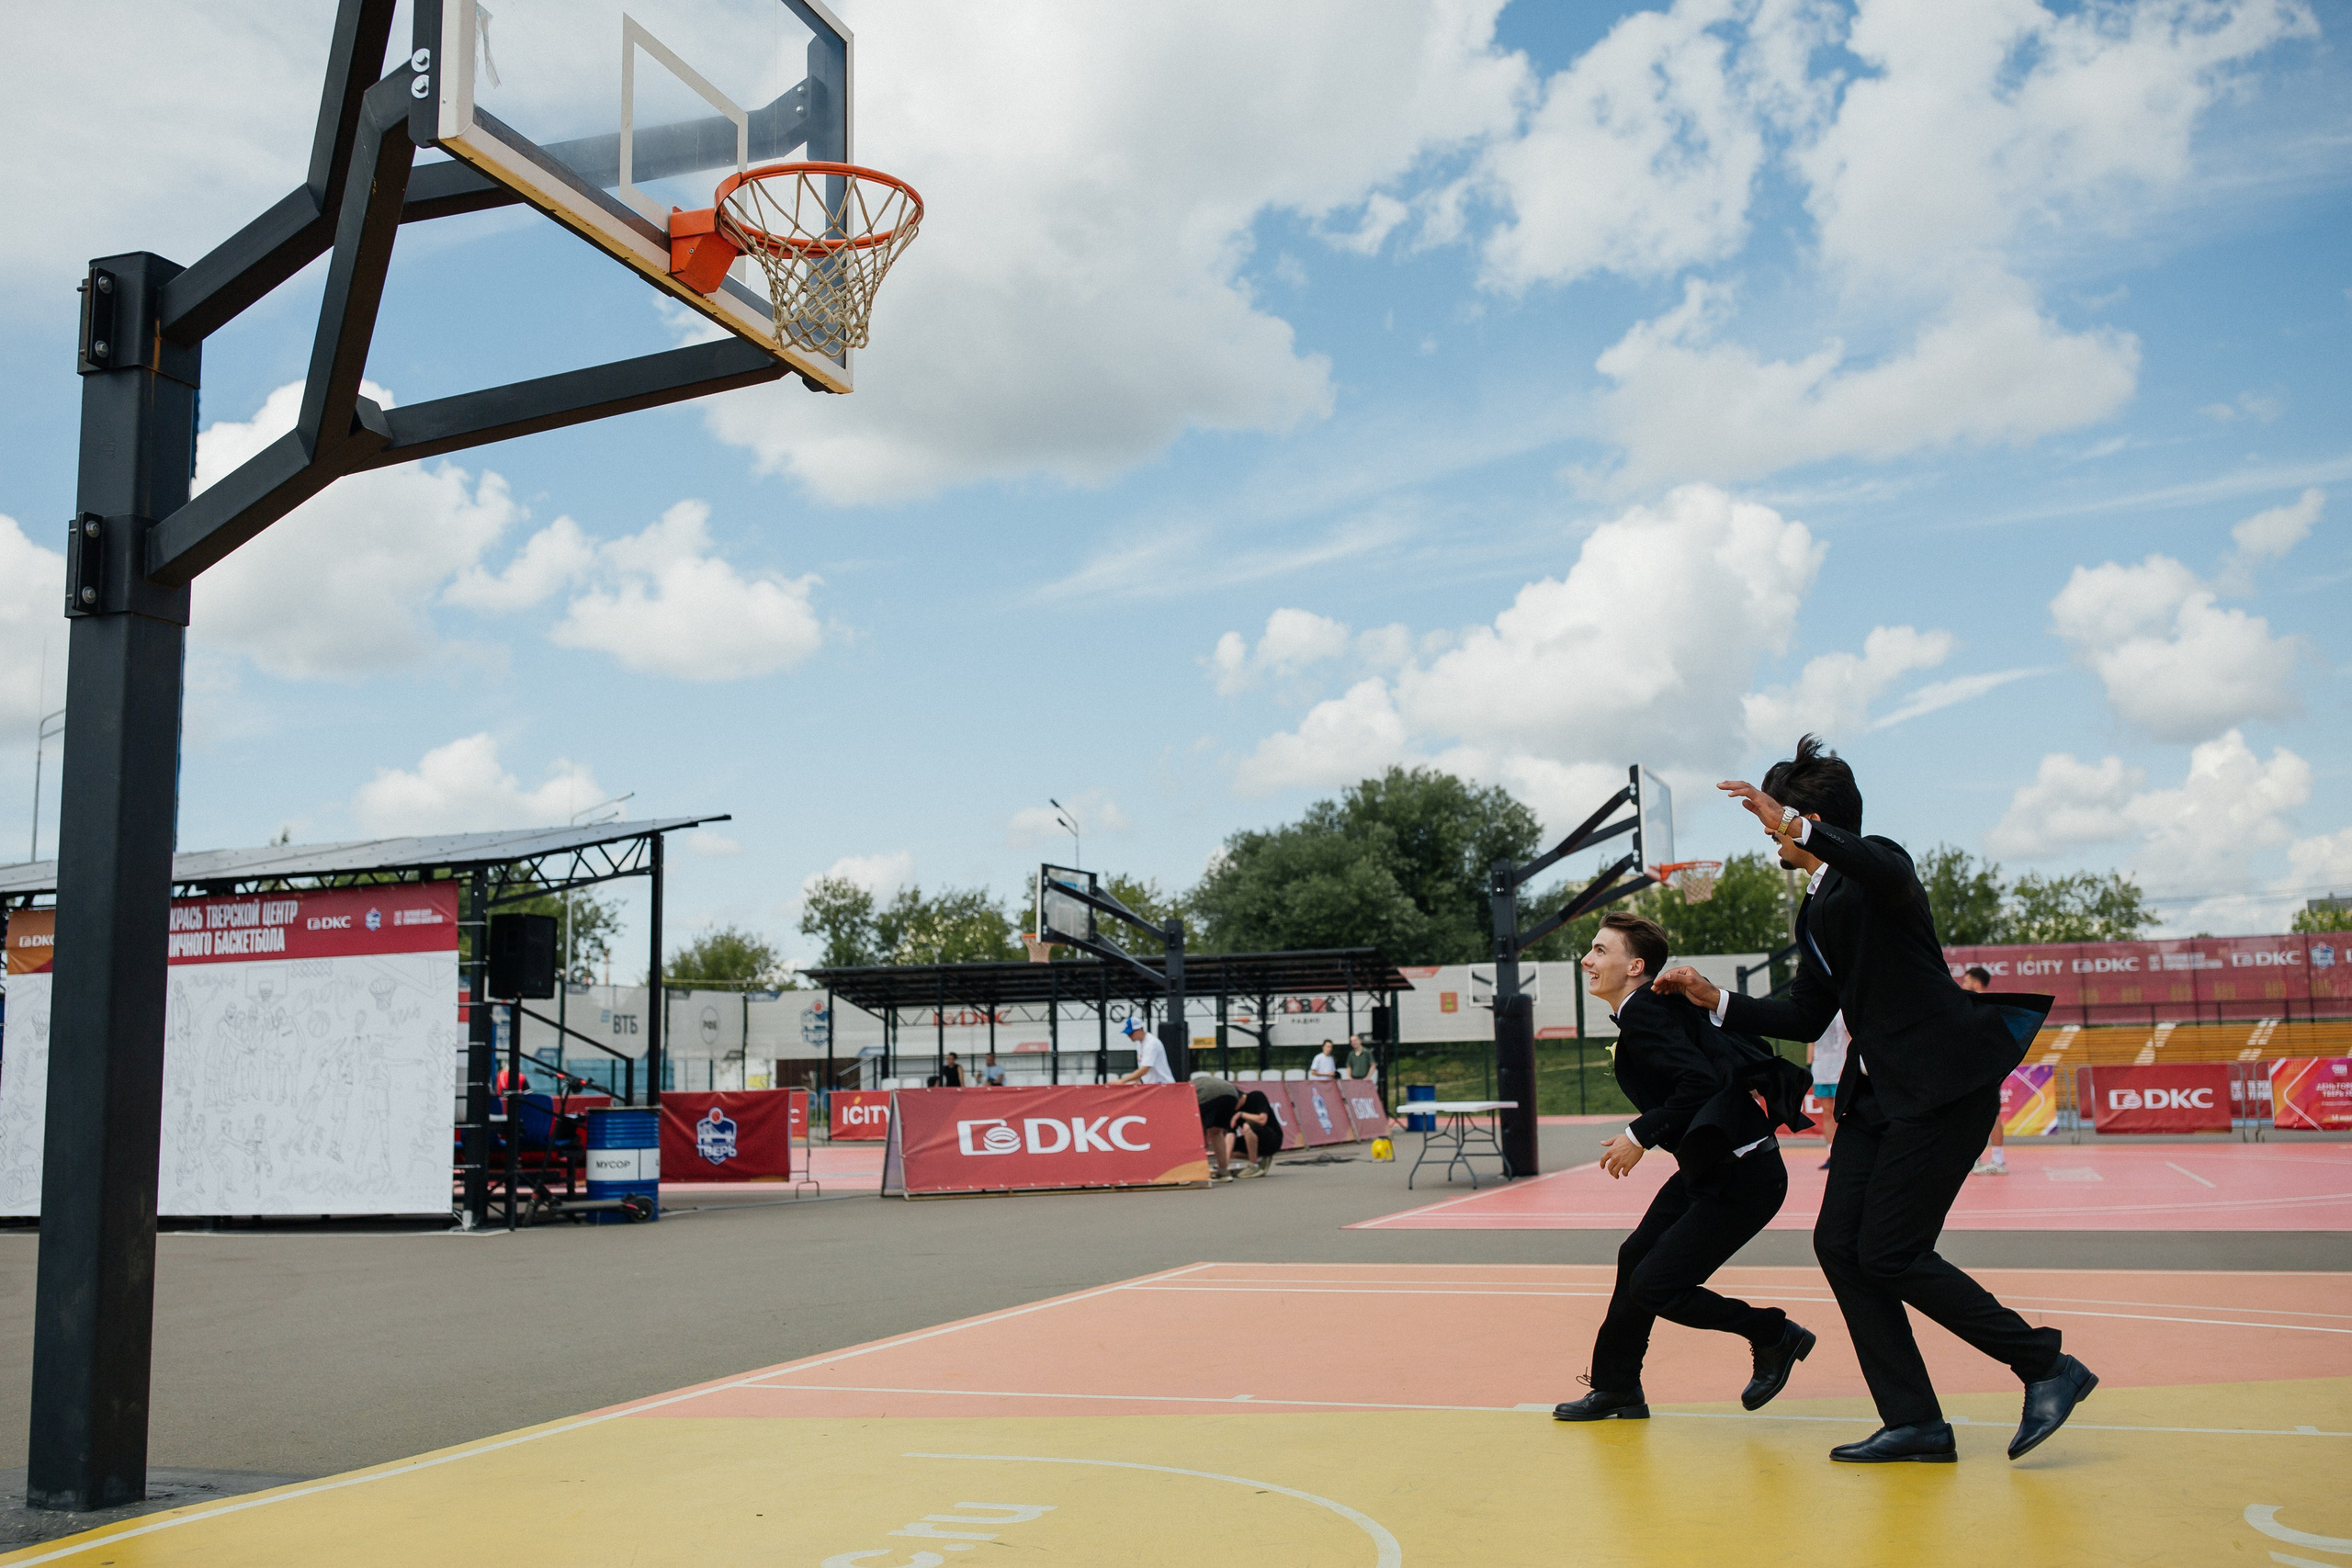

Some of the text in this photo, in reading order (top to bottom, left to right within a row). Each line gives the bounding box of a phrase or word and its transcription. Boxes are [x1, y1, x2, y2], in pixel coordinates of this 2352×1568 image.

[206, 898, 261, 929] ТВЕРСКОЙ
[262, 900, 299, 927] ЦЕНТР
[322, 916, 351, 929] DKC
[214, 928, 286, 955] БАСКЕТБОЛА
[2095, 957, 2140, 973] DKC
[2256, 951, 2301, 965] DKC
[2017, 960, 2063, 976] ICITY
[613, 1014, 639, 1034] ВТБ
[2144, 1088, 2214, 1110] DKC
[1023, 1115, 1150, 1154] DKC
[595, 1160, 631, 1169] МУСОР
